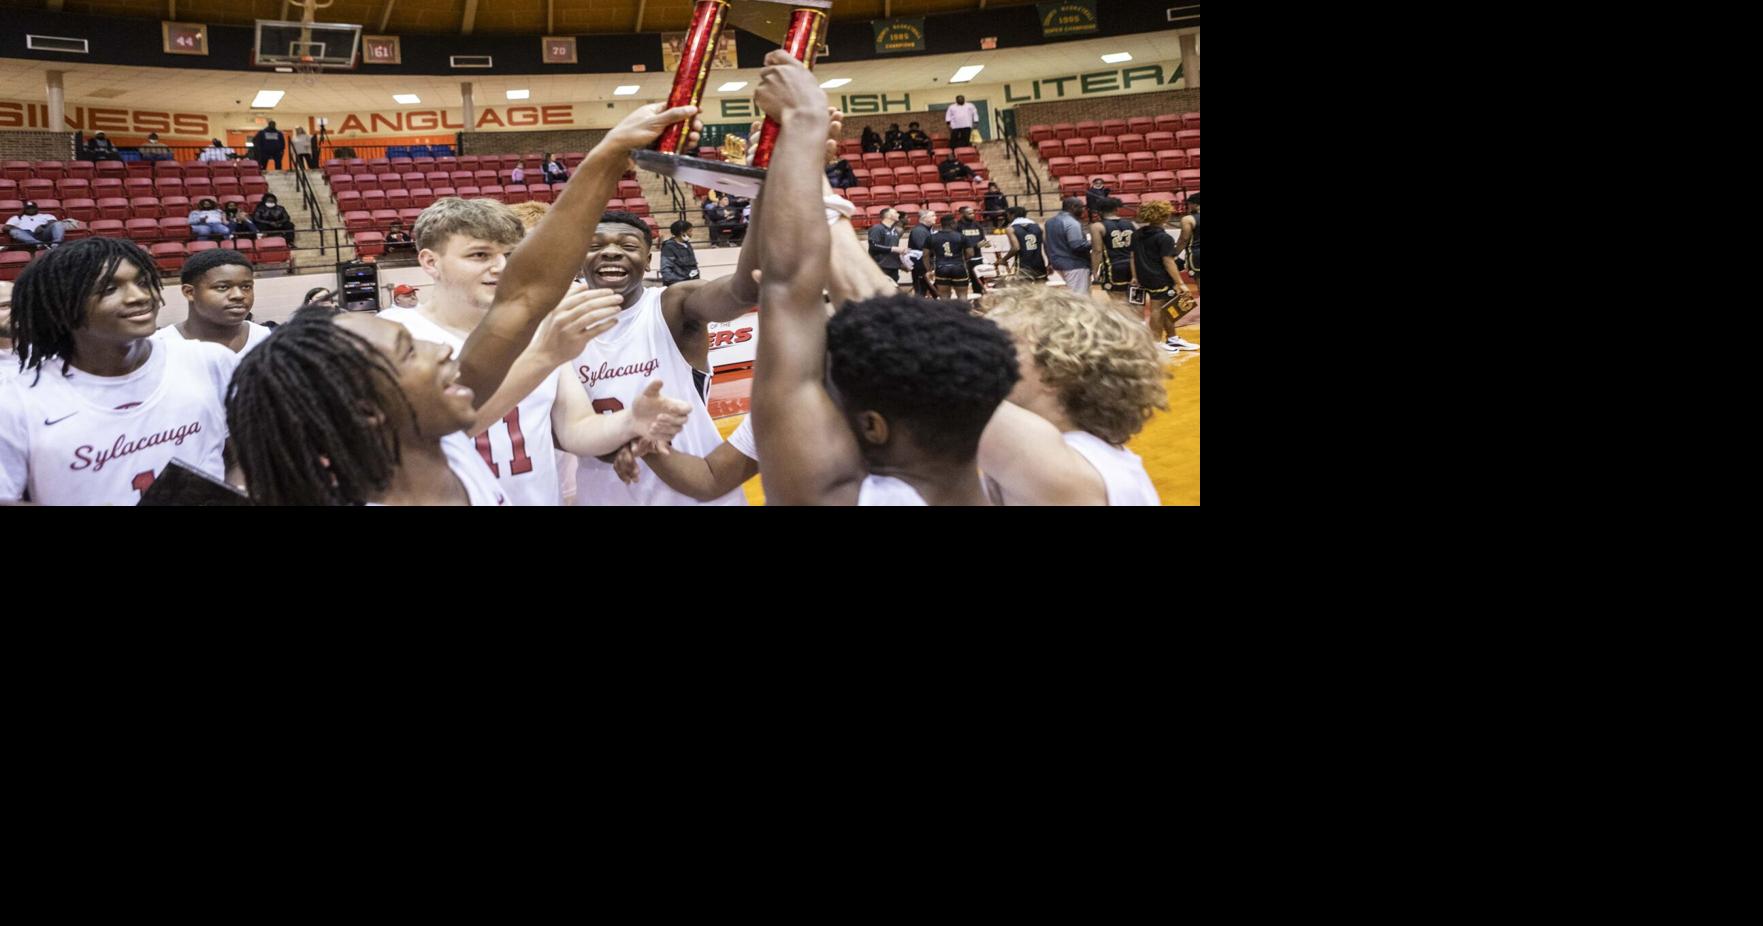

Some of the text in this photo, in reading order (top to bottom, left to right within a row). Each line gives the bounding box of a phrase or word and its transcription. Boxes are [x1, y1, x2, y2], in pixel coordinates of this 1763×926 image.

[374, 46, 389, 58] 61
[552, 47, 566, 56] 70
[720, 93, 911, 118] EISH
[1024, 234, 1038, 251] 2
[1110, 229, 1134, 249] 23
[942, 241, 954, 257] 1
[69, 421, 202, 472] Sylacauga
